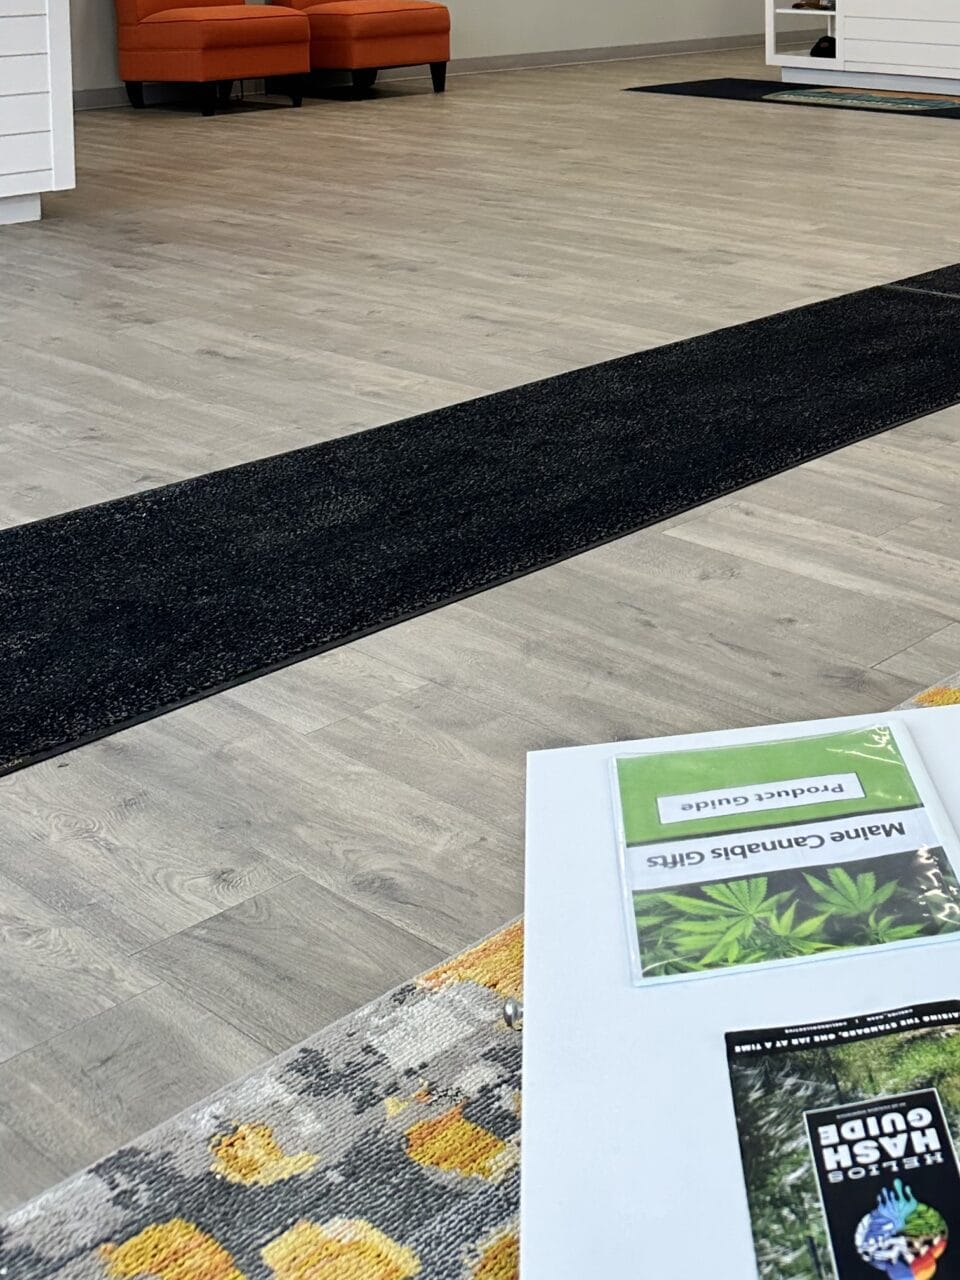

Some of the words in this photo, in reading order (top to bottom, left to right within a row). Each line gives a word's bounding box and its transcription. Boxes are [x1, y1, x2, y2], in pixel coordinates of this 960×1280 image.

[754, 783, 845, 802] Product
[680, 795, 750, 812] Guide
[830, 821, 906, 843] Maine
[711, 834, 825, 861] Cannabis
[646, 850, 705, 869] Gifts
[837, 1022, 898, 1038] STANDARD,
[899, 1017, 920, 1026] THE
[764, 1041, 772, 1049] A
[774, 1039, 789, 1048] AT
[791, 1036, 810, 1045] JAR
[812, 1033, 836, 1042] ONE
[734, 1043, 762, 1053] TIME
[817, 1107, 933, 1146] GUIDE
[821, 1127, 942, 1171] HASH
[826, 1151, 944, 1183] HELIOS
